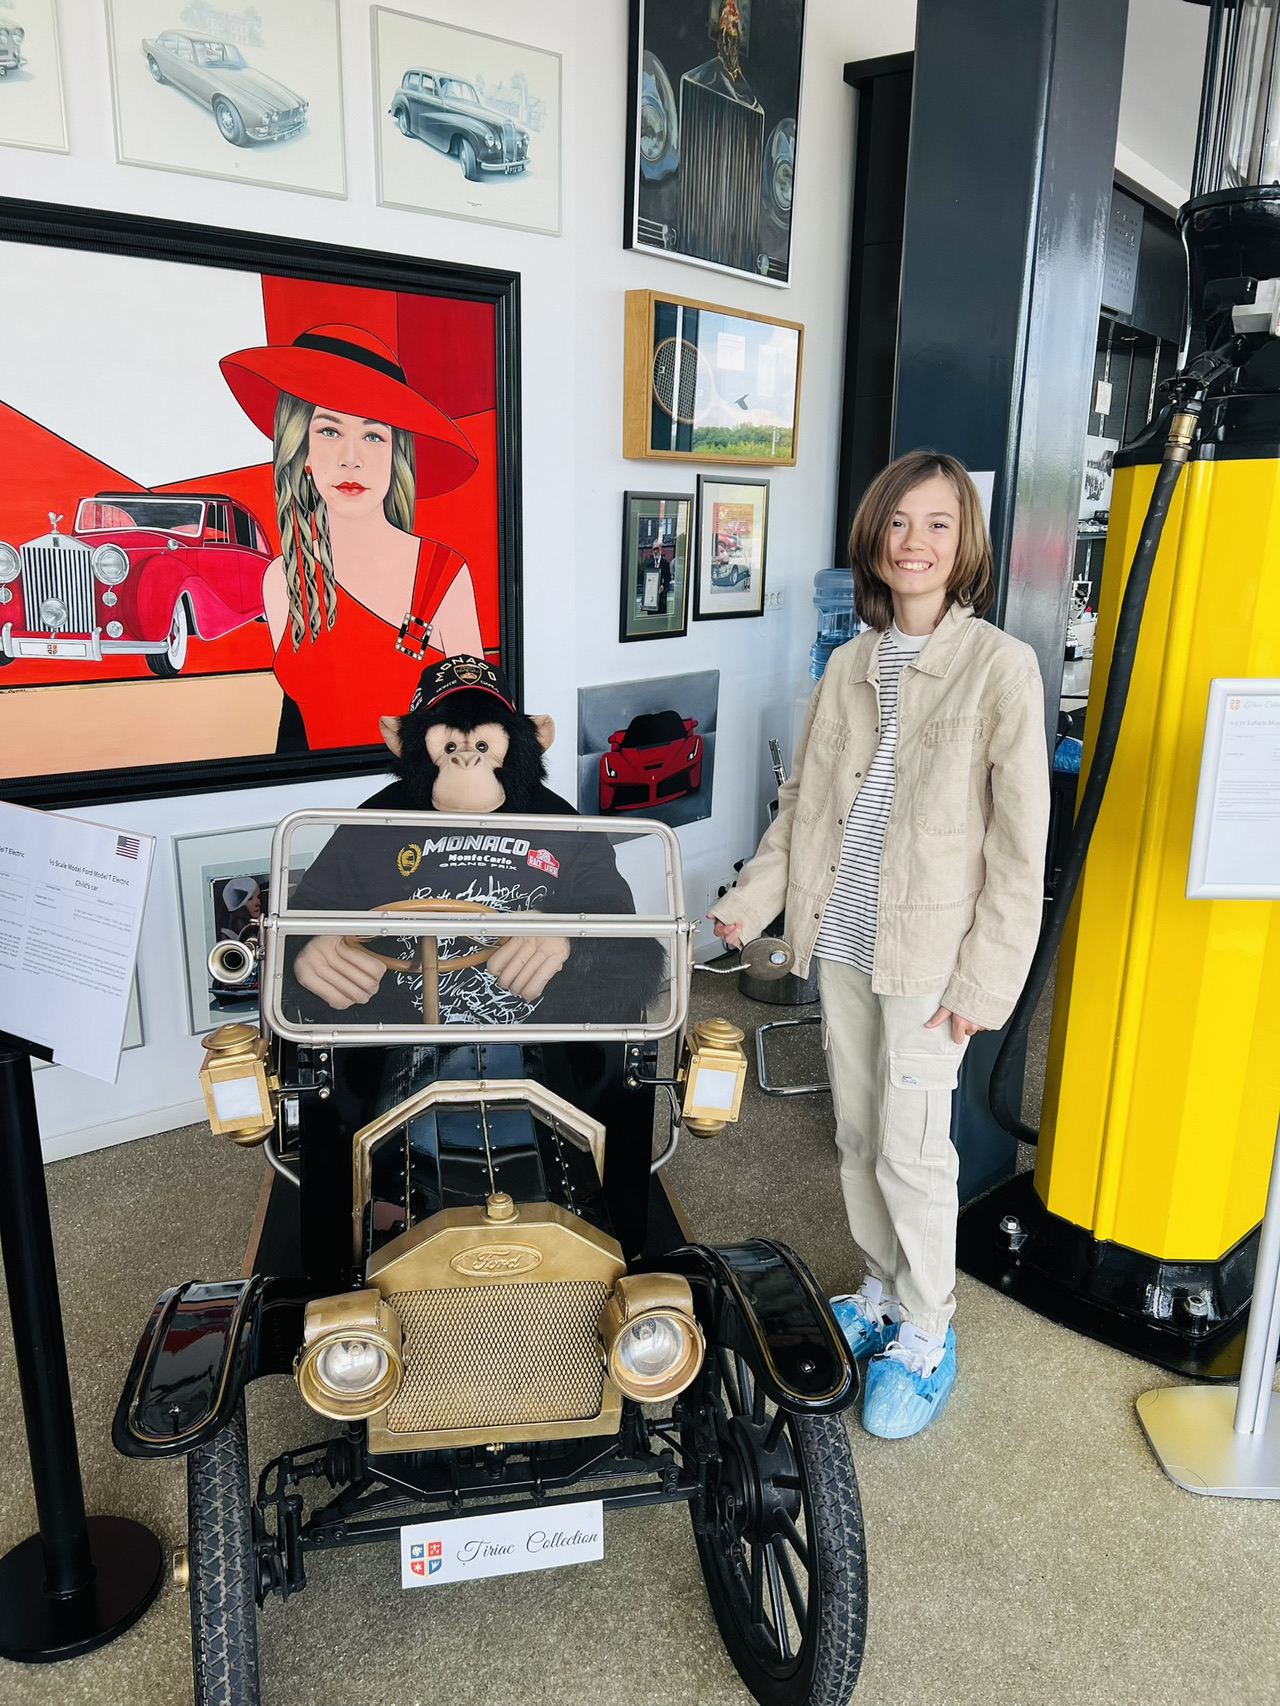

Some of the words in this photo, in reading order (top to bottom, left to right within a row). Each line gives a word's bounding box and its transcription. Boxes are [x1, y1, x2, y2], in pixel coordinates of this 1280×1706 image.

[435, 657, 497, 683] MONACO
[9, 848, 25, 858] Electric
[422, 835, 531, 857] MONACO
[55, 859, 67, 870] Scale
[68, 863, 82, 874] Model
[82, 867, 94, 877] Ford
[94, 869, 108, 881] Model
[112, 875, 130, 887] Electric
[491, 863, 518, 871] PRIX
[75, 880, 91, 890] Child's
[472, 1249, 522, 1271] Ford
[526, 1530, 599, 1553] Collection
